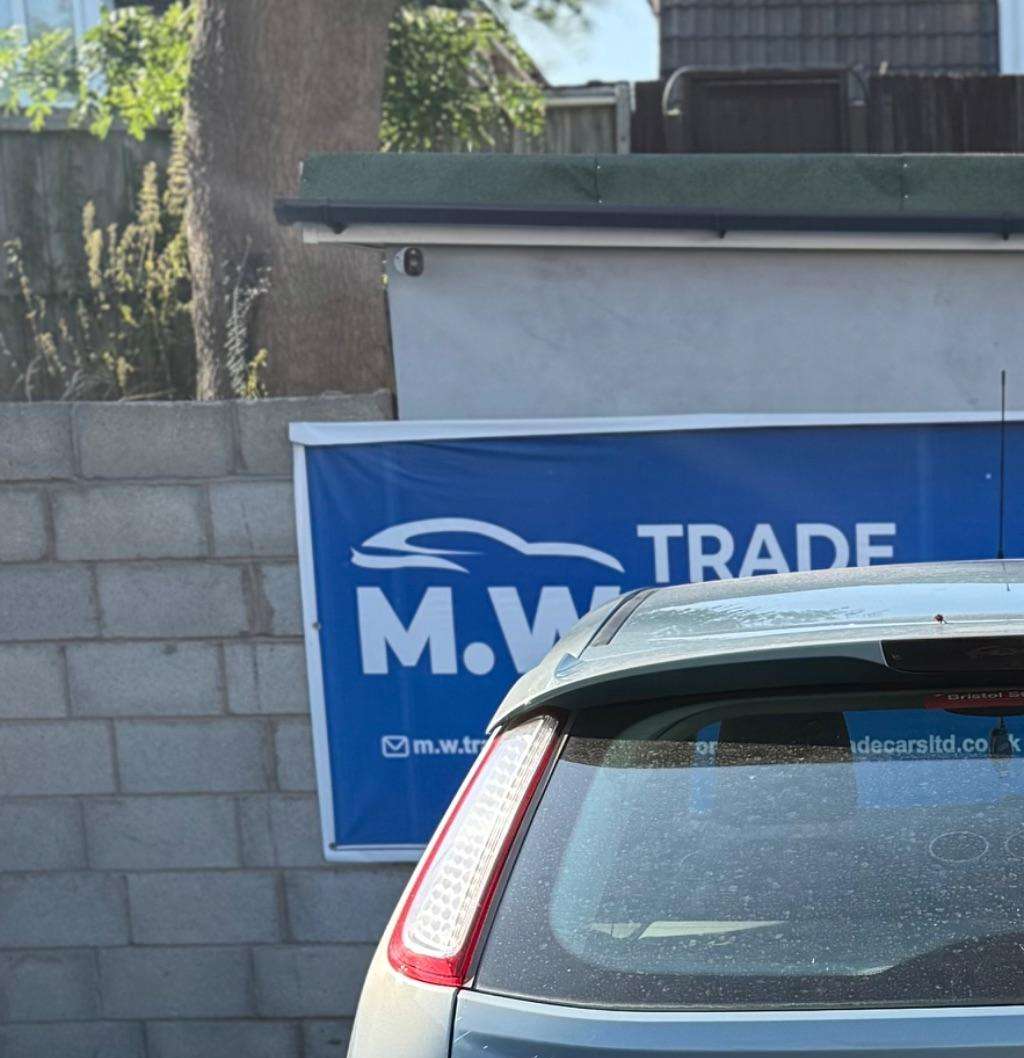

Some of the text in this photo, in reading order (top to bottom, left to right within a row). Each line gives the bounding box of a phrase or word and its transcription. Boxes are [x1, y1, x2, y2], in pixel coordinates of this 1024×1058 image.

[636, 522, 896, 584] TRADE
[356, 586, 621, 676] M.W
[413, 735, 486, 755] m.w.tr
